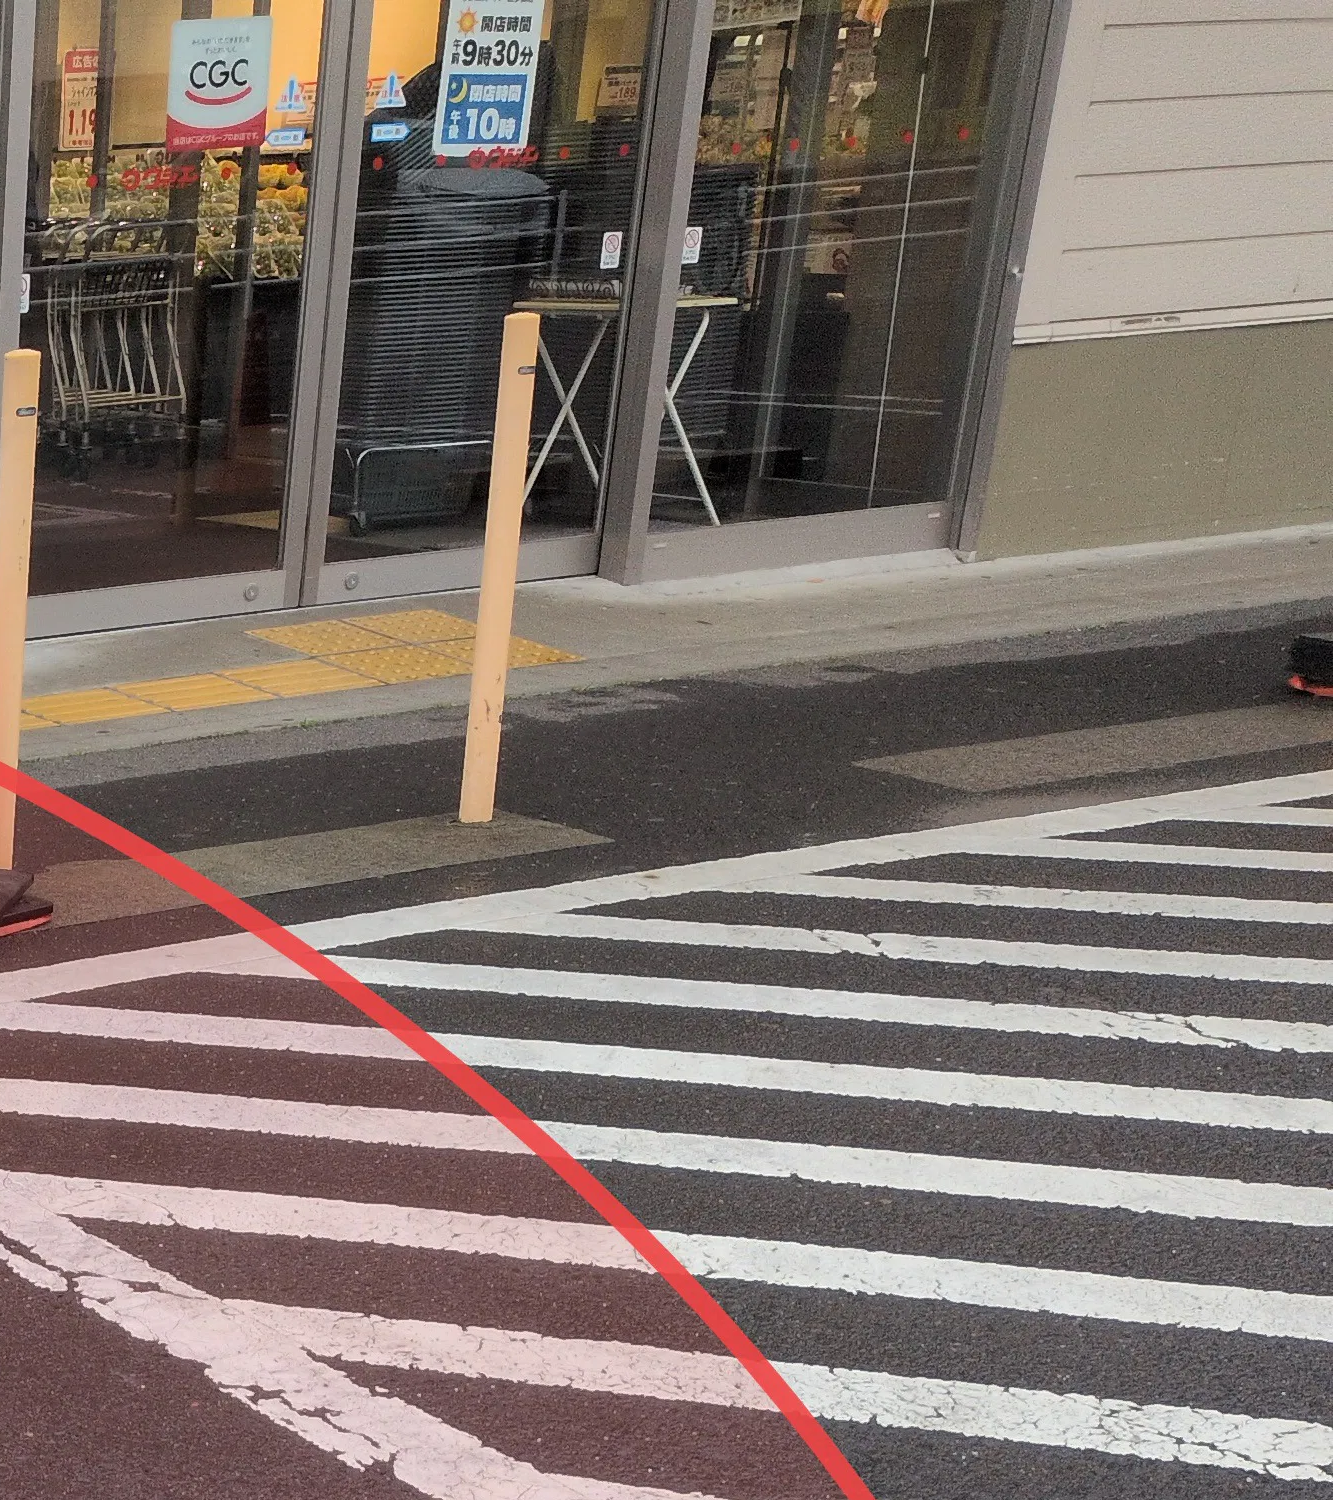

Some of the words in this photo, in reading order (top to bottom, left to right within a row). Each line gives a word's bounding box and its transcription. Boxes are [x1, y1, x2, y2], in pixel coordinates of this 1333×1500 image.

[480, 15, 532, 33] 開店時間
[189, 58, 249, 89] CGC
[469, 84, 523, 103] 閉店時間
[466, 108, 517, 140] 10時
